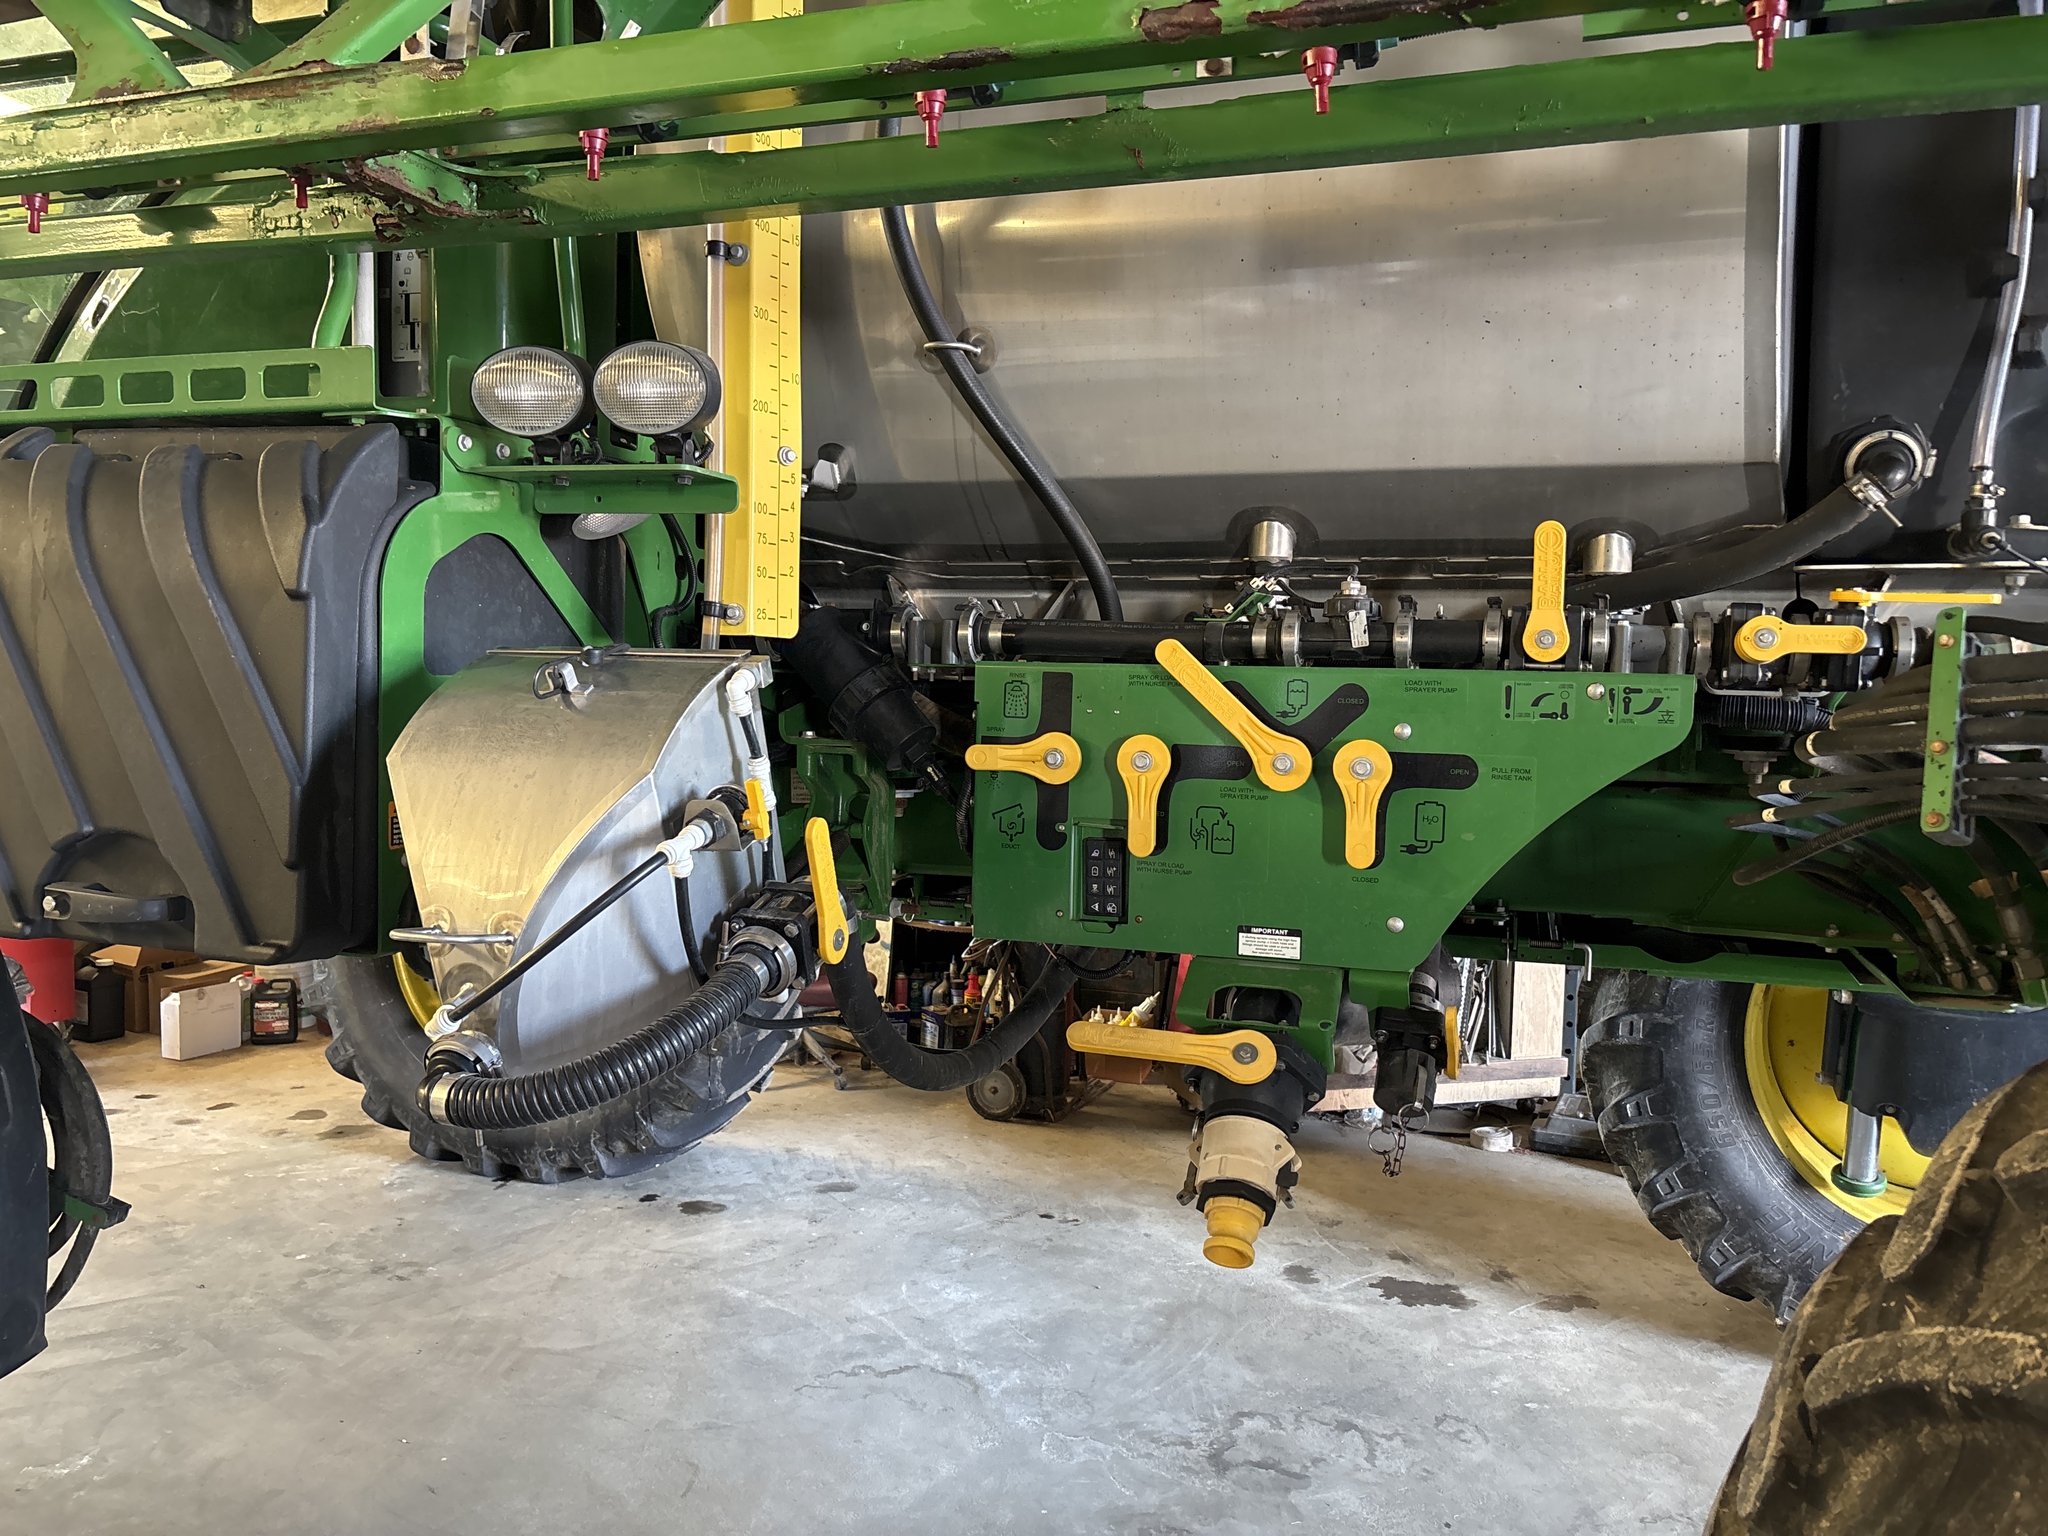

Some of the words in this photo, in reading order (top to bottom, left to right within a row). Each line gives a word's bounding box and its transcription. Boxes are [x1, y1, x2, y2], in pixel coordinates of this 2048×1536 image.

[754, 219, 770, 234] 400
[791, 234, 800, 247] 15
[753, 306, 769, 321] 300
[791, 373, 800, 385] 10
[753, 399, 769, 413] 200
[790, 473, 796, 485] 5
[753, 502, 768, 514] 100
[790, 501, 795, 513] 4
[757, 533, 768, 544] 75
[789, 532, 795, 543] 3
[756, 566, 767, 578] 50
[789, 566, 794, 577] 2
[756, 608, 767, 620] 25
[1404, 679, 1423, 687] LOAD
[1337, 697, 1365, 705] CLOSED
[1491, 766, 1508, 774] PULL
[1510, 767, 1531, 775] FROM
[1513, 774, 1533, 782] TANK
[1220, 792, 1249, 800] SPRAYER
[1153, 867, 1174, 875] NURSE
[1168, 862, 1185, 870] LOAD
[1351, 876, 1380, 884] CLOSED
[1250, 927, 1289, 936] IMPORTANT
